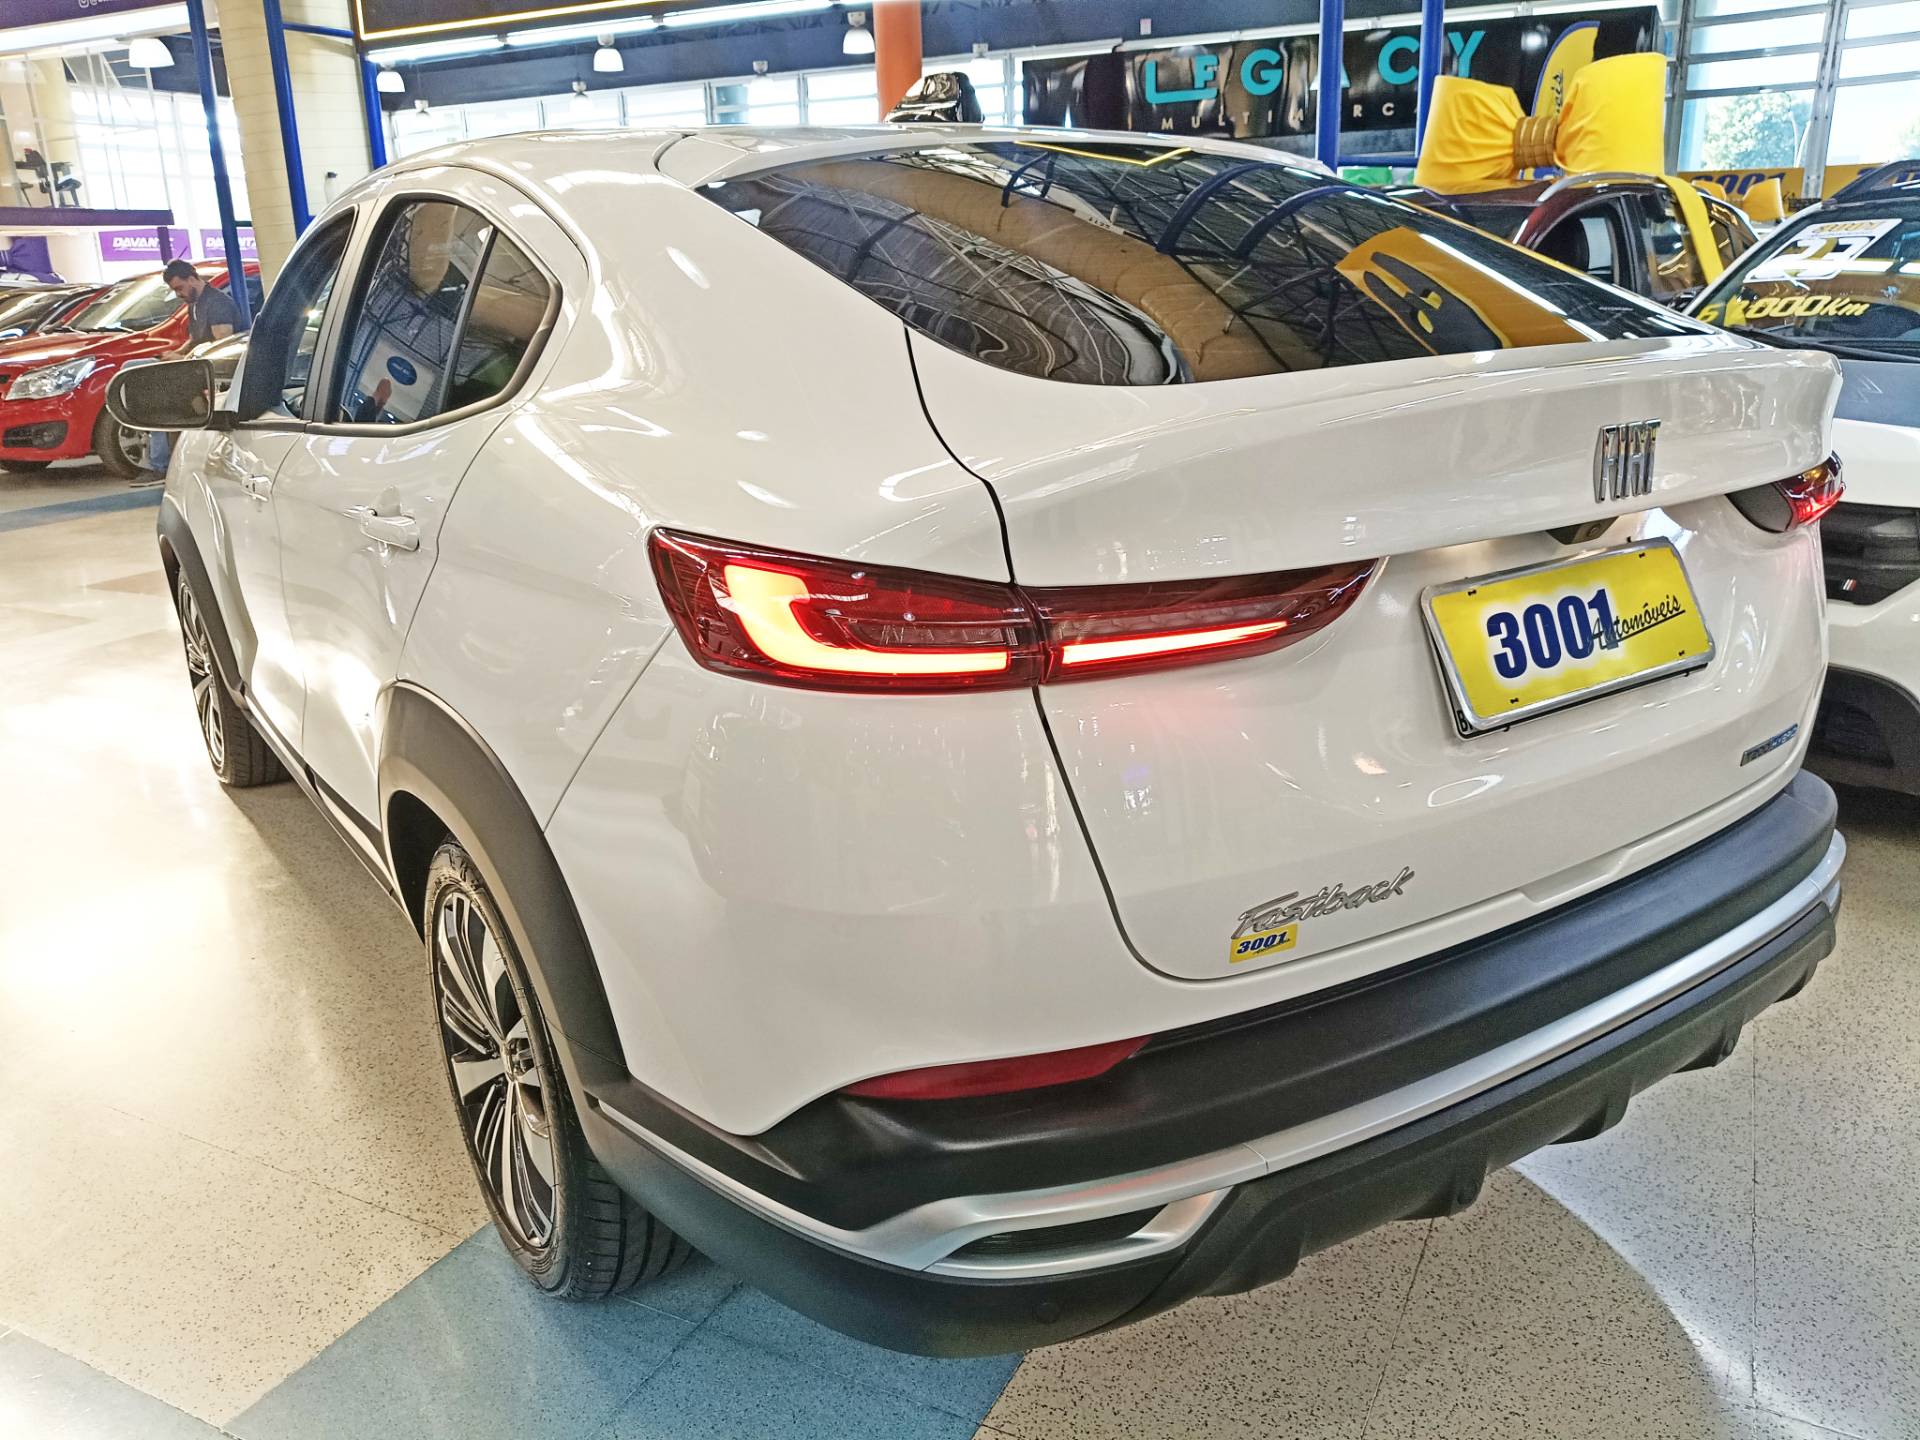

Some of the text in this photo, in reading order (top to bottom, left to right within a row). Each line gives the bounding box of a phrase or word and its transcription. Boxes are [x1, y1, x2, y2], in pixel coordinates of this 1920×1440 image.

[1593, 419, 1661, 503] FIAT
[1487, 588, 1618, 678] 3001
[1231, 866, 1415, 939] Fastback
[1237, 931, 1288, 954] 3001
